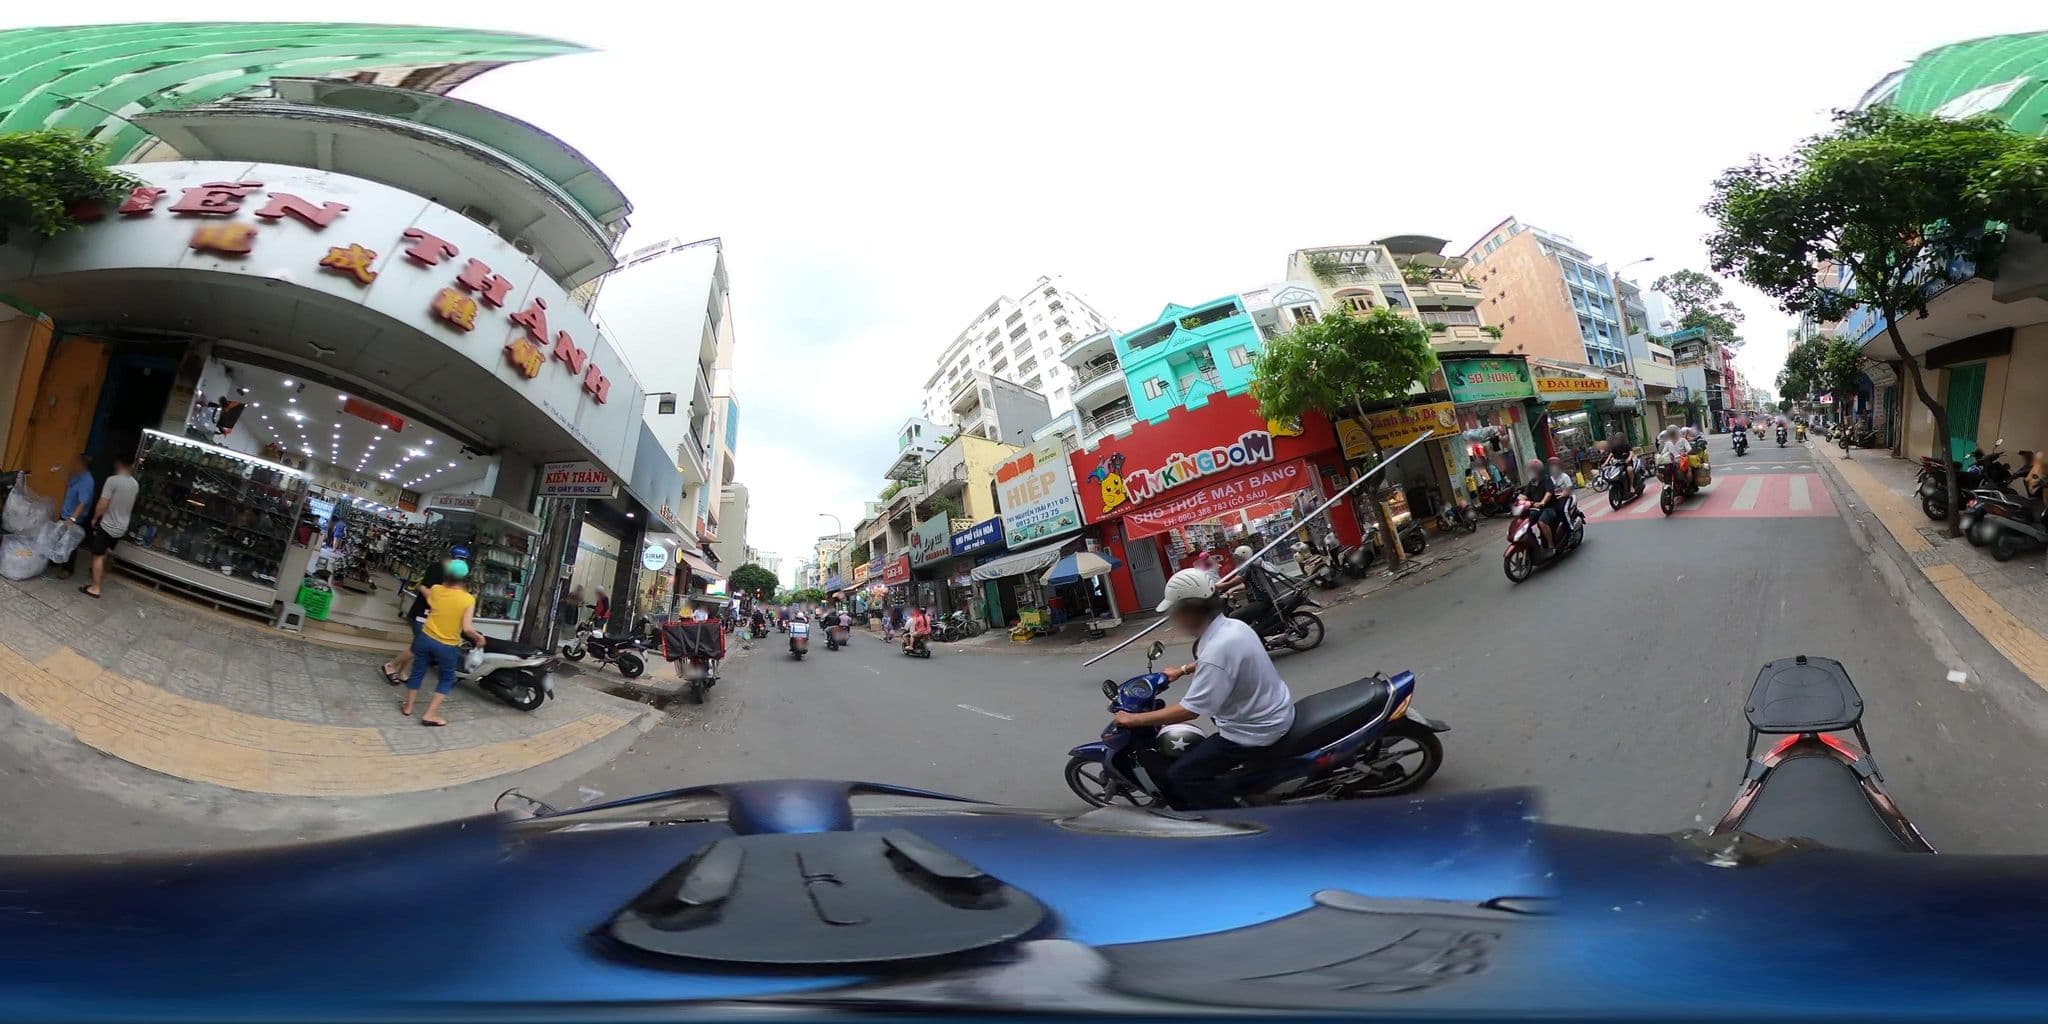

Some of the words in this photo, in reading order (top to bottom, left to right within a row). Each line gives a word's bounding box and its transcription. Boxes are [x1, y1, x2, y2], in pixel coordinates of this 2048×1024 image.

[70, 181, 349, 228] IẾN
[1124, 430, 1274, 504] MYKINGDOM
[1006, 471, 1057, 510] HIỆP
[1133, 506, 1163, 525] CHO
[1167, 491, 1209, 515] THUÊ
